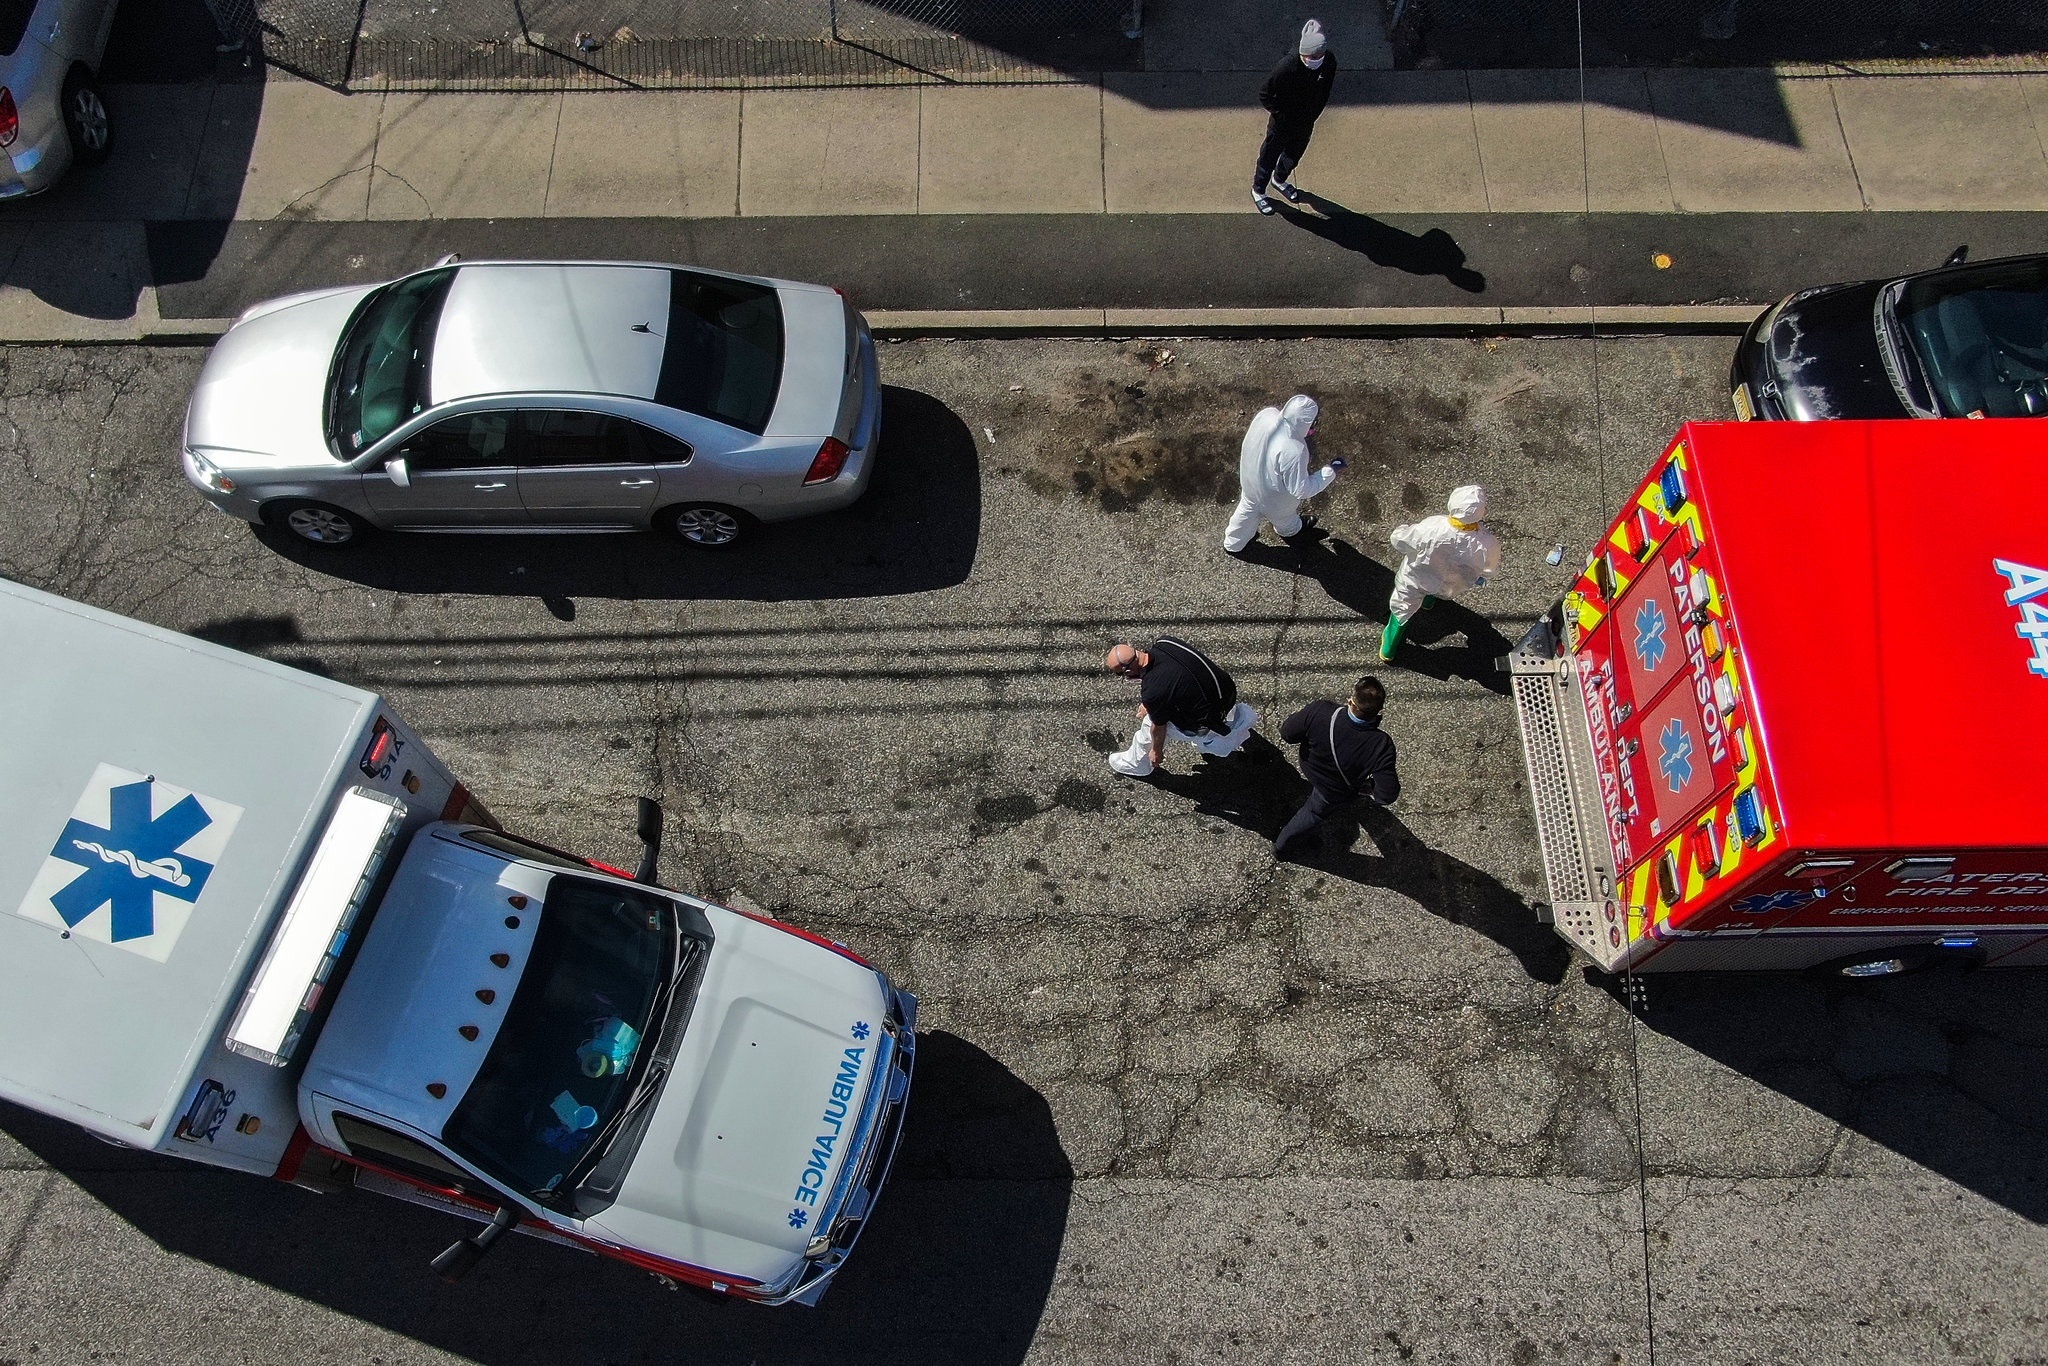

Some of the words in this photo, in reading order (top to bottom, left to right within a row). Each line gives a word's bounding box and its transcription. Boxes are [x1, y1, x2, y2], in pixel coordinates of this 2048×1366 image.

[1670, 557, 1726, 764] PATERSON
[1600, 659, 1622, 730] FIRE
[1580, 661, 1629, 865] AMBULANCE
[1828, 907, 1930, 915] EMERGENCY
[1885, 886, 1979, 896] FIRE
[205, 1089, 236, 1144] A36
